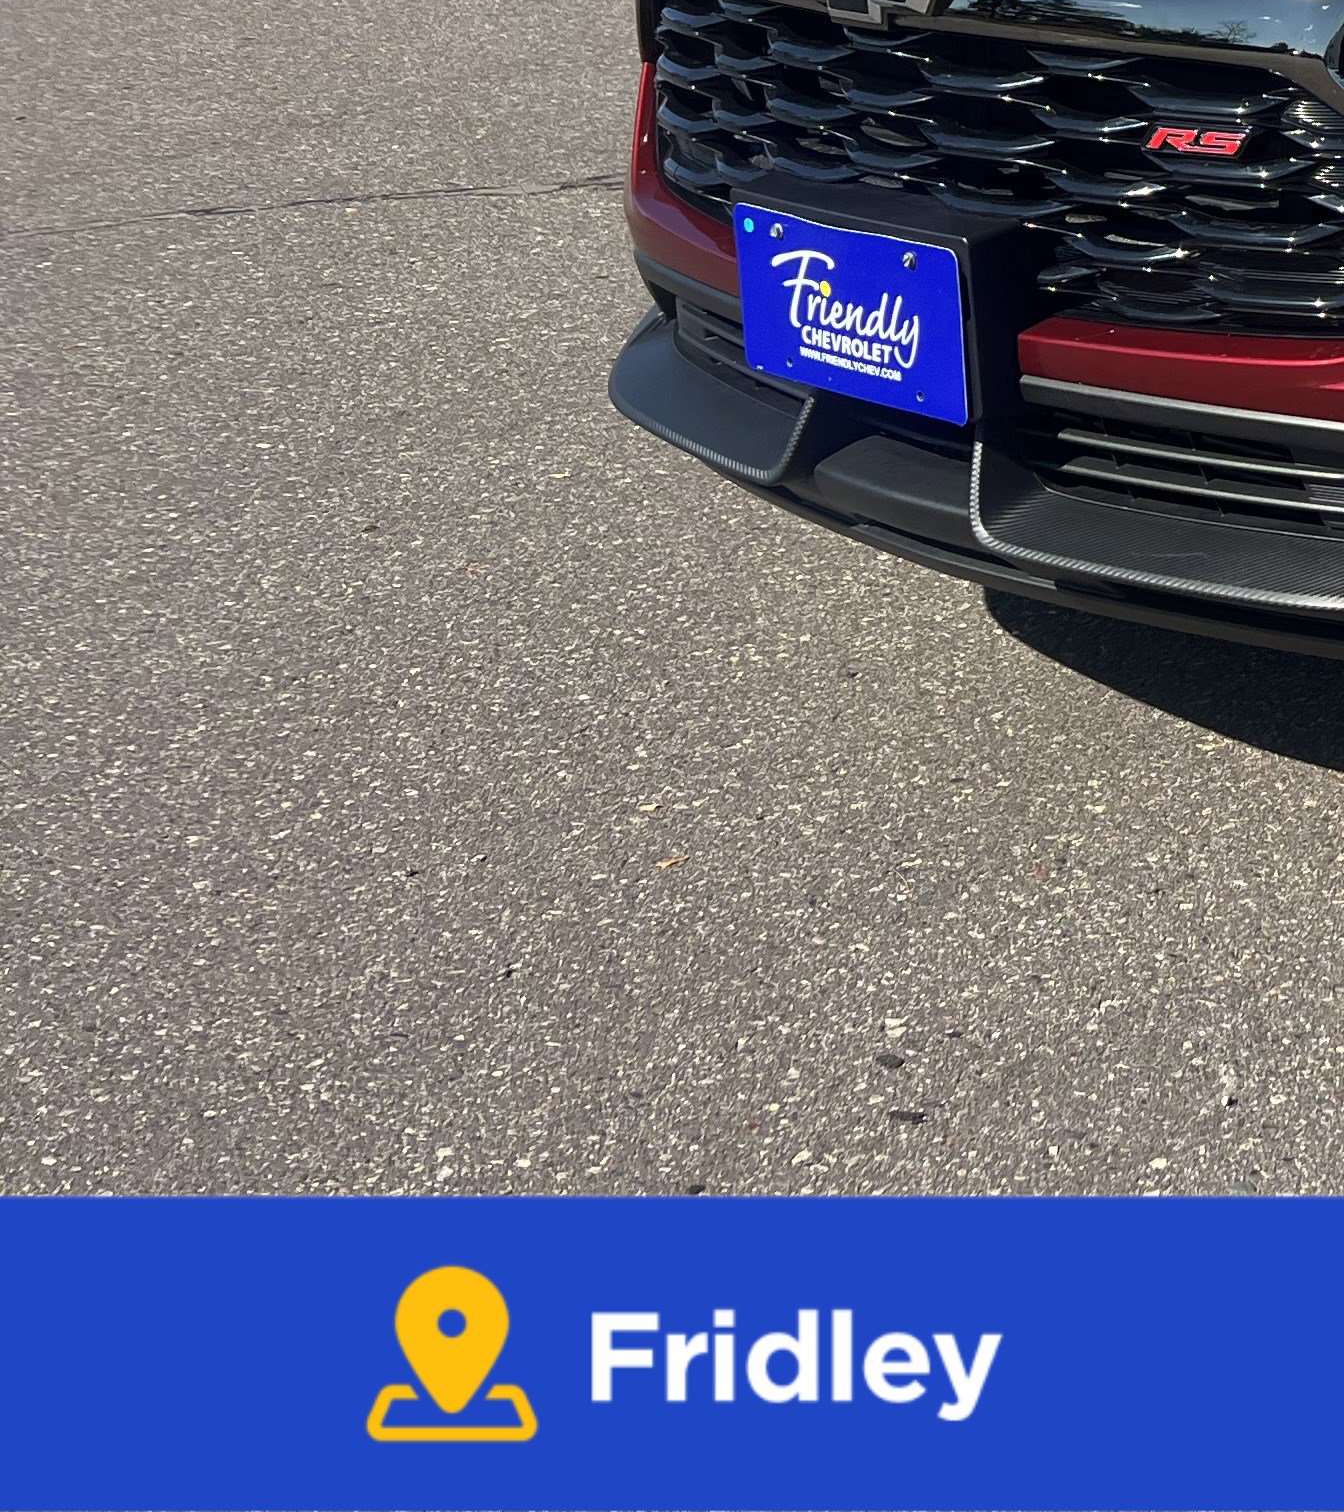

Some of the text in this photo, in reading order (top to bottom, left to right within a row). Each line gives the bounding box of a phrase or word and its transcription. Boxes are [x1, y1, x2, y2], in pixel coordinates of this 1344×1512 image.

[1146, 127, 1246, 156] RS
[770, 249, 920, 369] Friendly
[799, 345, 902, 382] WWW.FRIENDLYCHEV.COM
[801, 325, 892, 364] CHEVROLET
